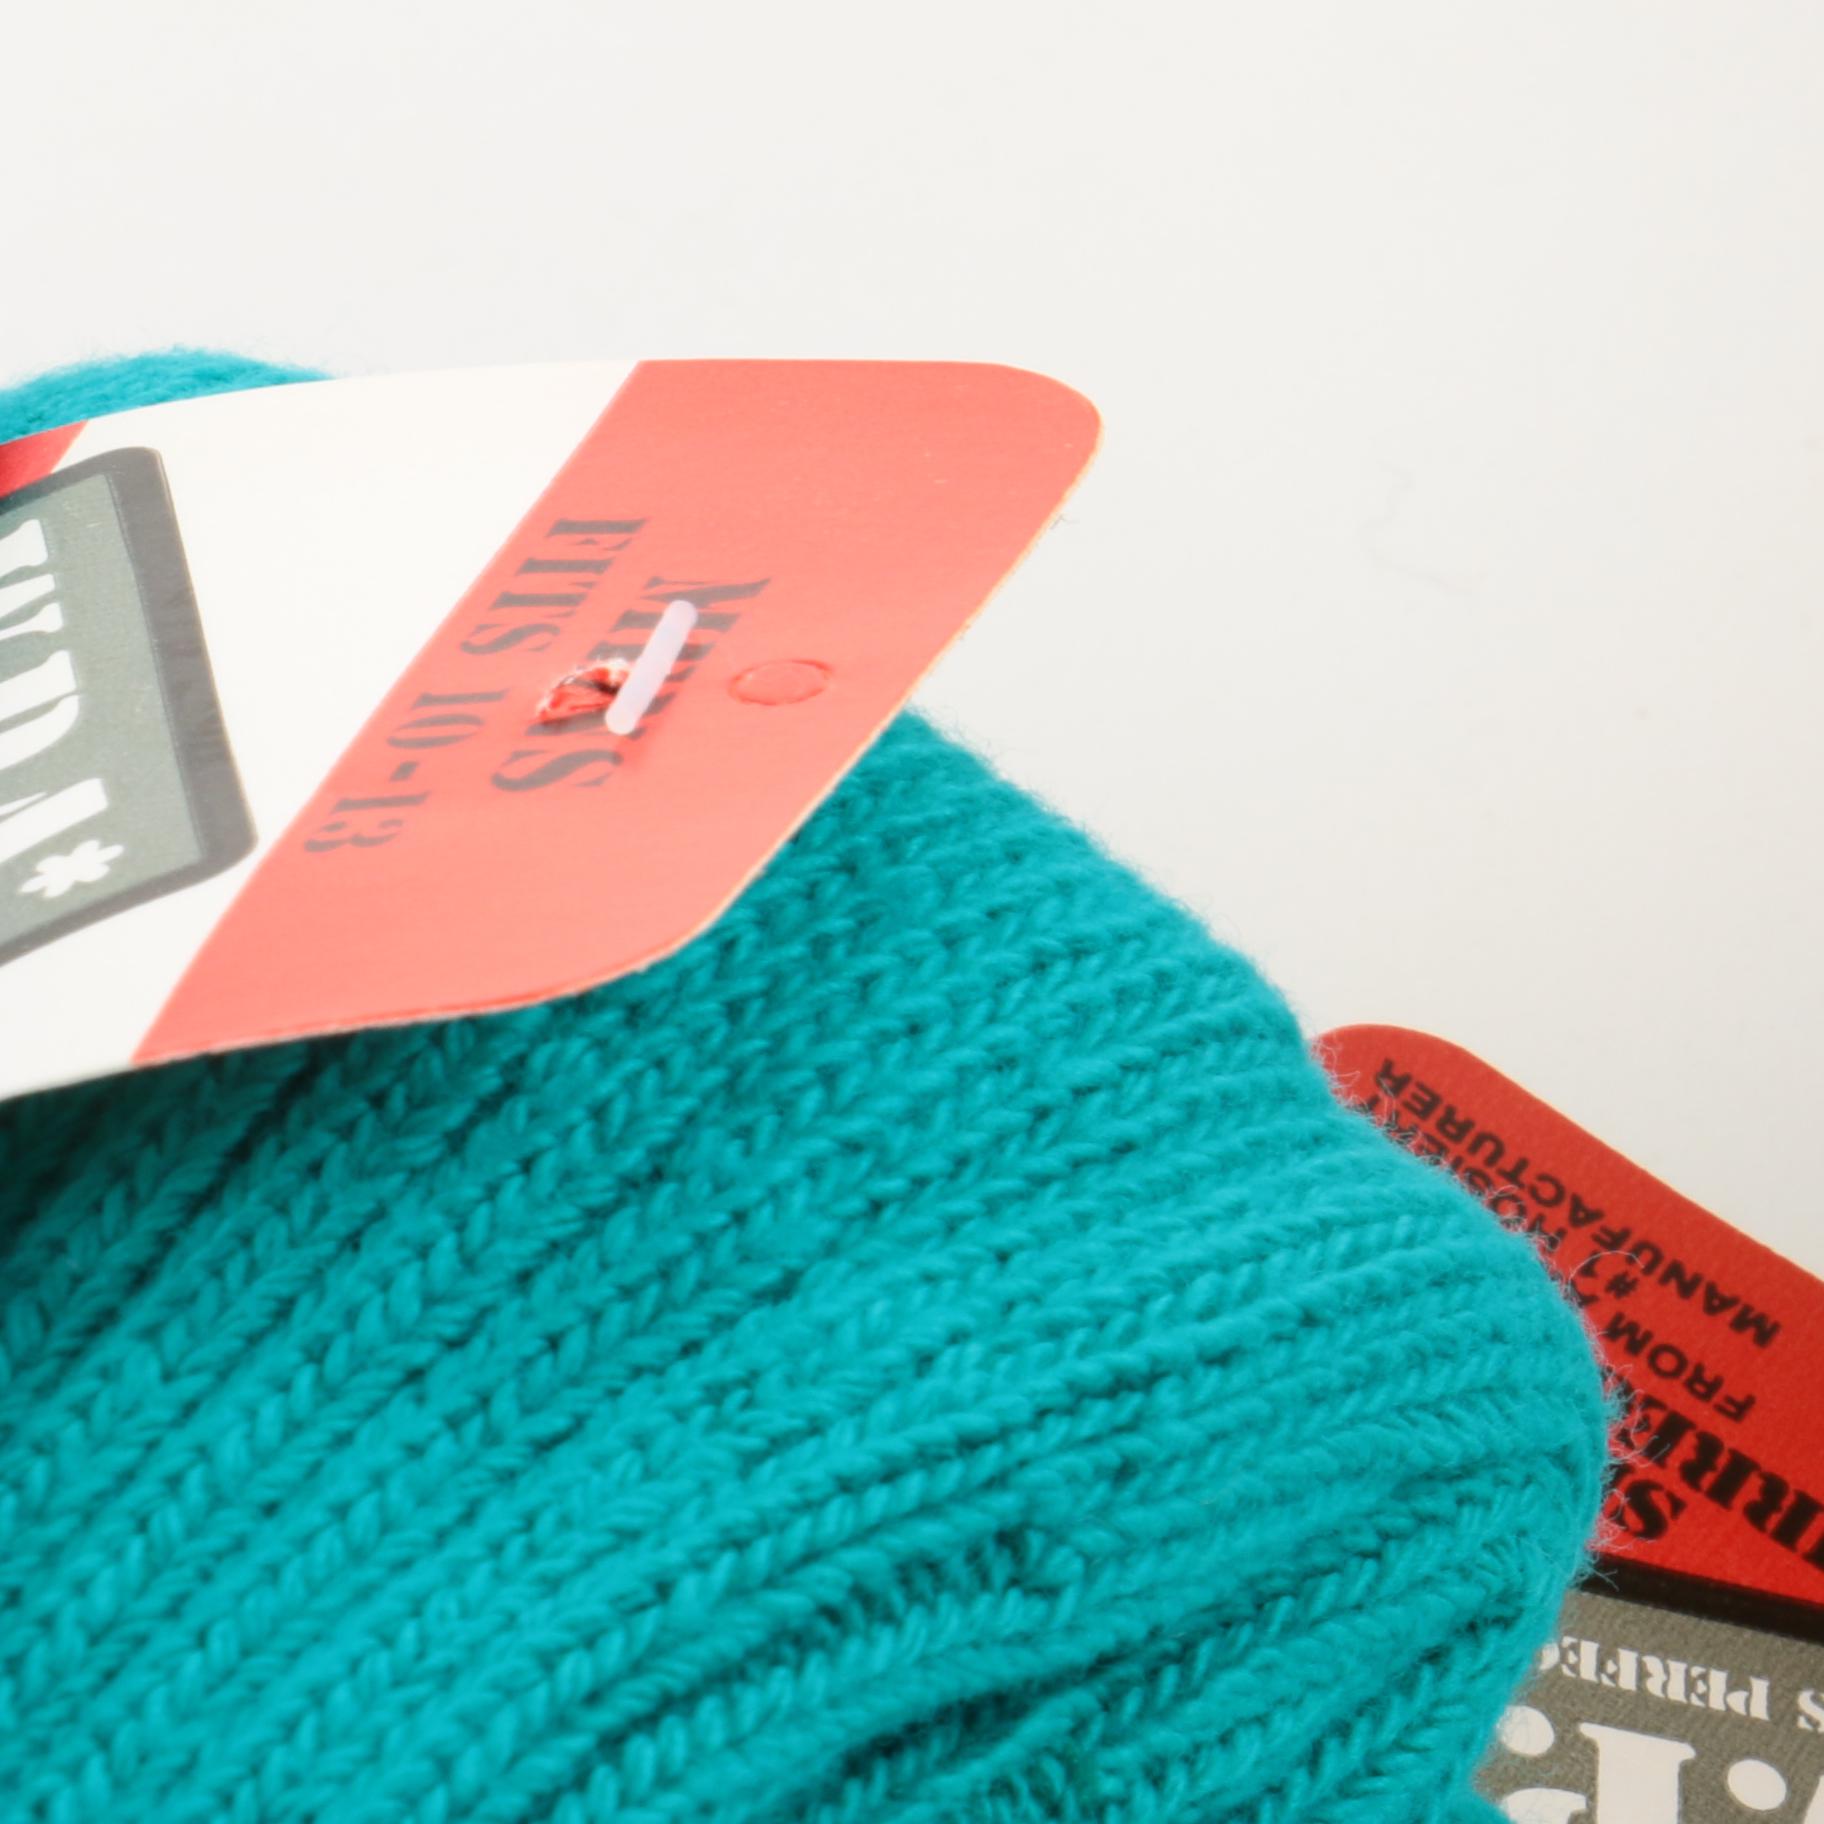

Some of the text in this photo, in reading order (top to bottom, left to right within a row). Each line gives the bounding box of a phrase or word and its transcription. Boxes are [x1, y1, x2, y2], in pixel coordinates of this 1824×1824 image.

[304, 518, 648, 853] FITS 10-13
[1373, 1057, 1782, 1349] MANUFACTURER
[1601, 1312, 1757, 1423] FROM
